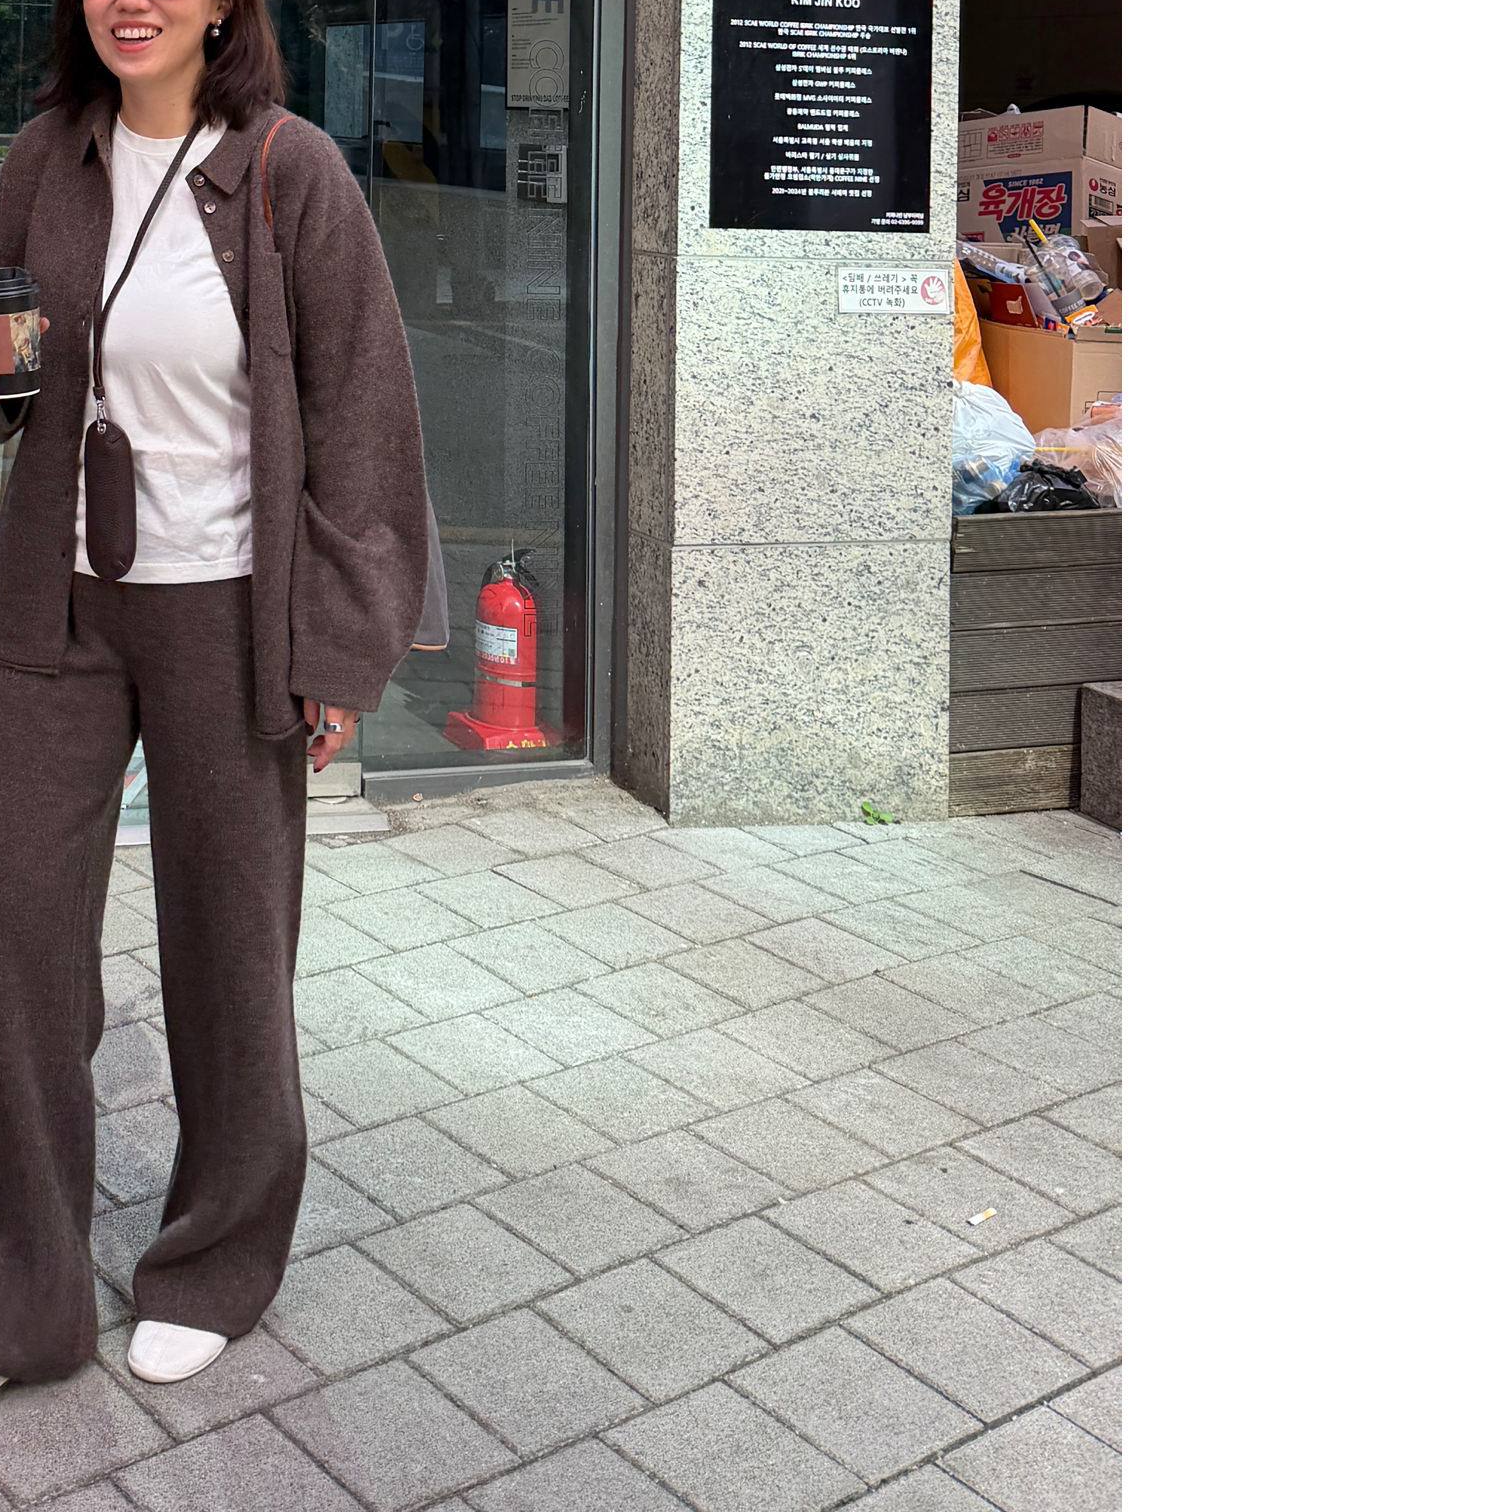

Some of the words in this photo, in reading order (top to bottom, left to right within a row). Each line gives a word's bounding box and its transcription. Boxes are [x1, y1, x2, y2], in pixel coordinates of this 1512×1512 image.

[758, 20, 778, 28] WORLD
[1008, 179, 1028, 188] SINCE
[977, 182, 1067, 223] 육개장
[874, 274, 898, 284] 쓰레기
[910, 274, 918, 284] 꼭
[842, 284, 874, 294] 휴지통에
[878, 285, 918, 295] 버려주세요
[859, 298, 883, 308] (CCTV
[886, 298, 906, 308] 녹화)
